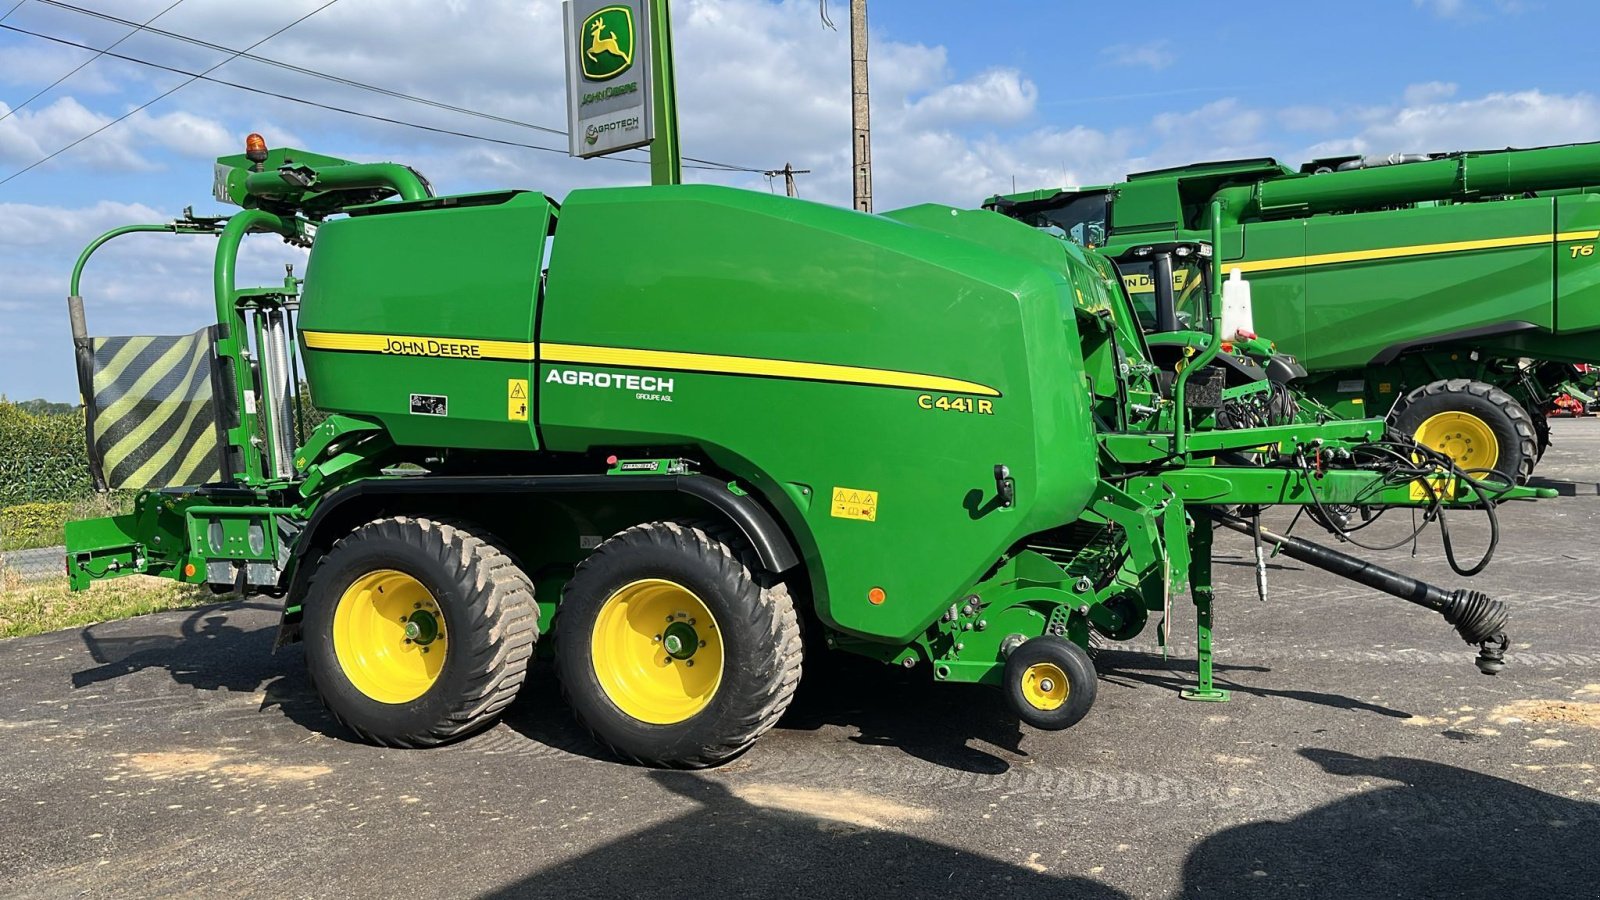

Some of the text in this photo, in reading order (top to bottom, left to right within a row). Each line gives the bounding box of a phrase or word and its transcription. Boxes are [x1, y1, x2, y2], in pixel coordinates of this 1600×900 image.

[593, 117, 639, 134] AGROTECH
[1569, 244, 1594, 258] T6
[383, 338, 481, 356] JOHN DEERE
[546, 369, 674, 392] AGROTECH
[636, 393, 660, 401] GROUPE
[978, 399, 994, 415] R
